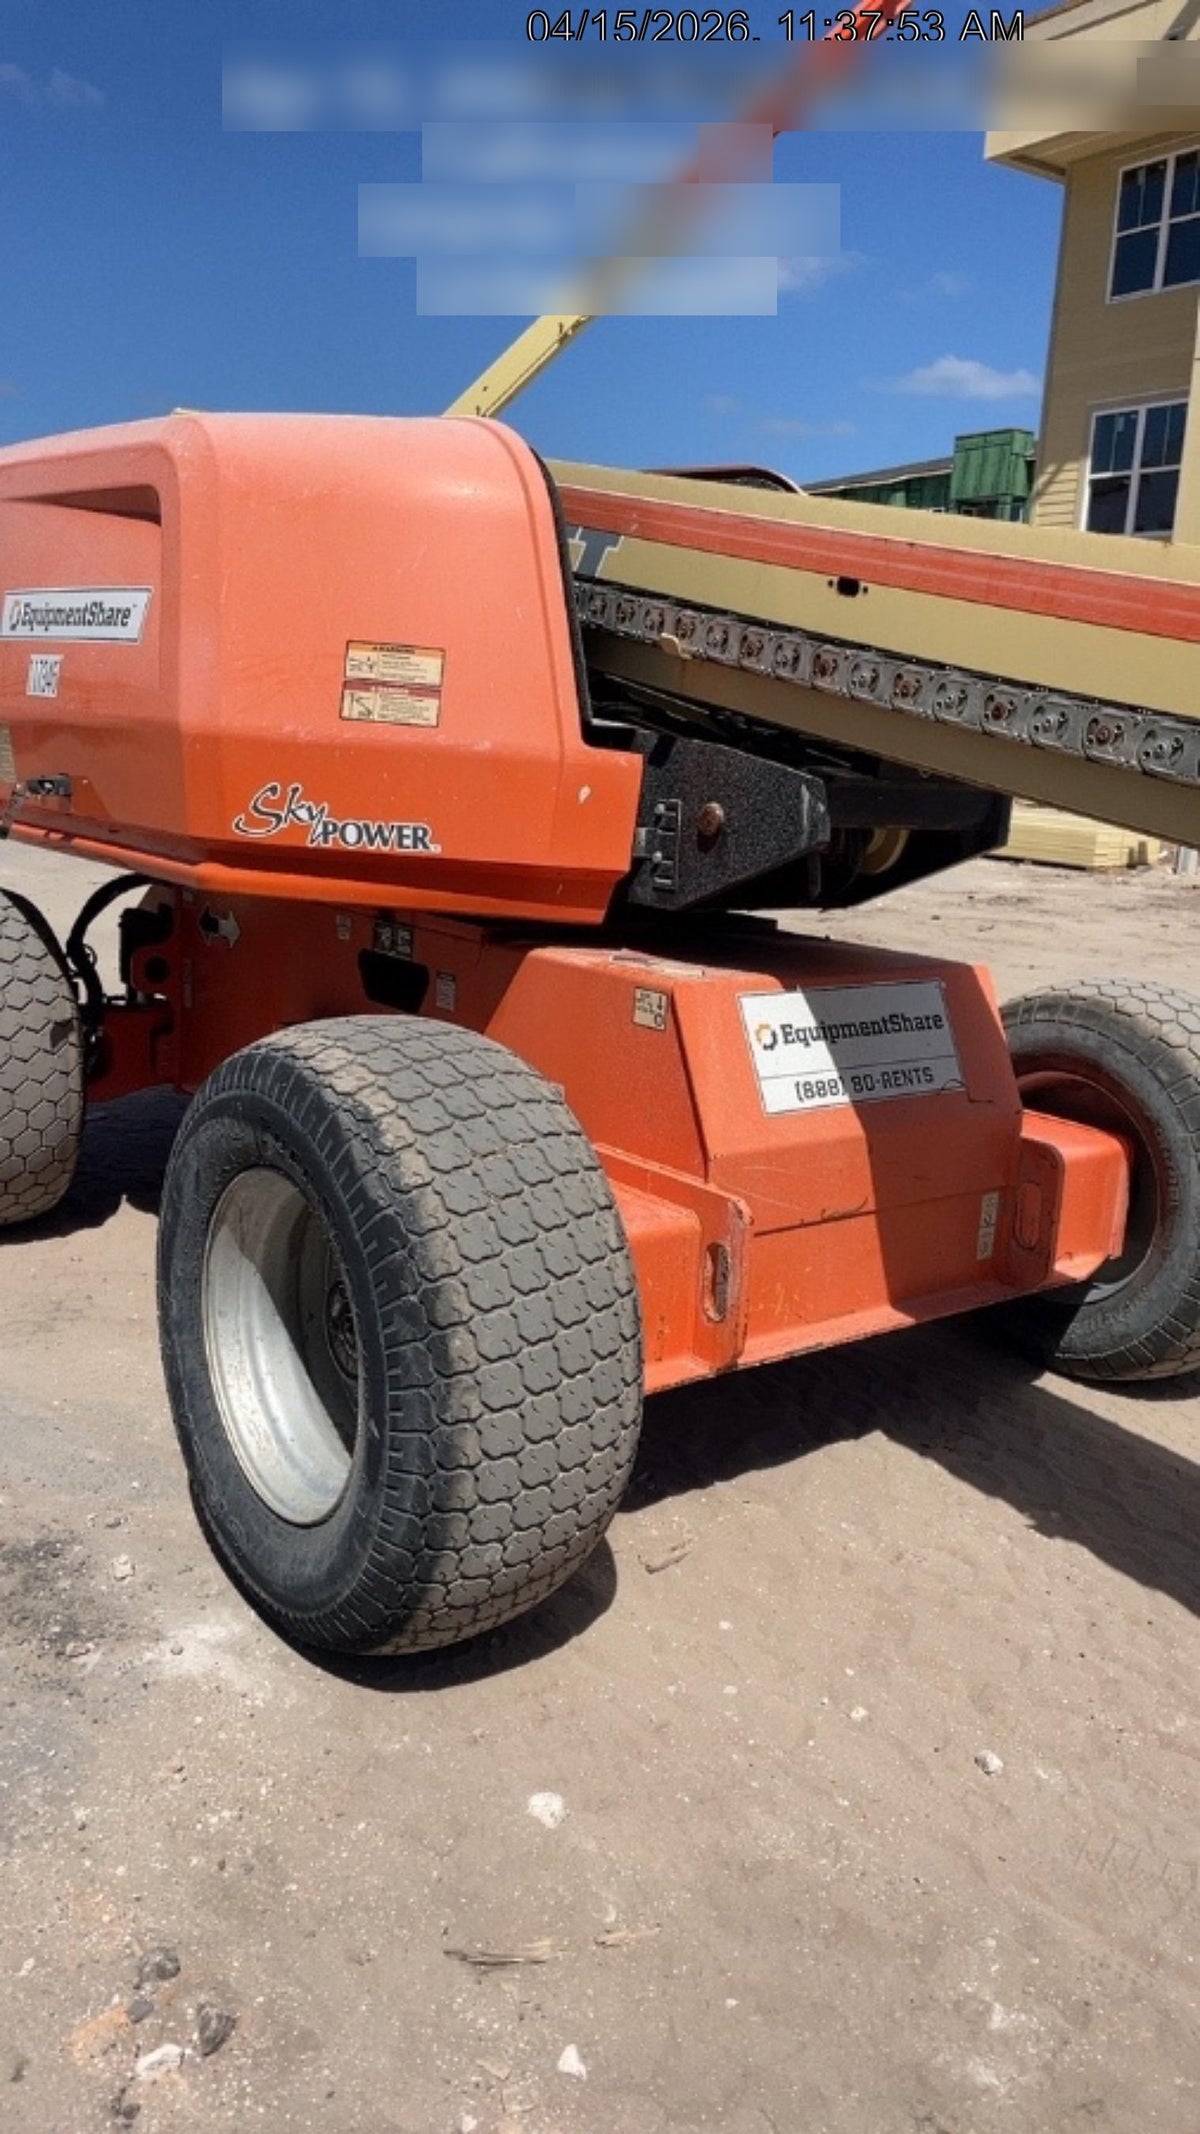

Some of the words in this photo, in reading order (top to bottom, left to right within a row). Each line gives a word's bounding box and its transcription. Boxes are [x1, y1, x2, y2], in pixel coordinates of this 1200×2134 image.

[21, 601, 132, 632] EquipmentShare
[780, 1013, 945, 1048] EquipmentShare
[794, 1076, 847, 1103] (888)
[851, 1066, 935, 1094] 80-RENTS
